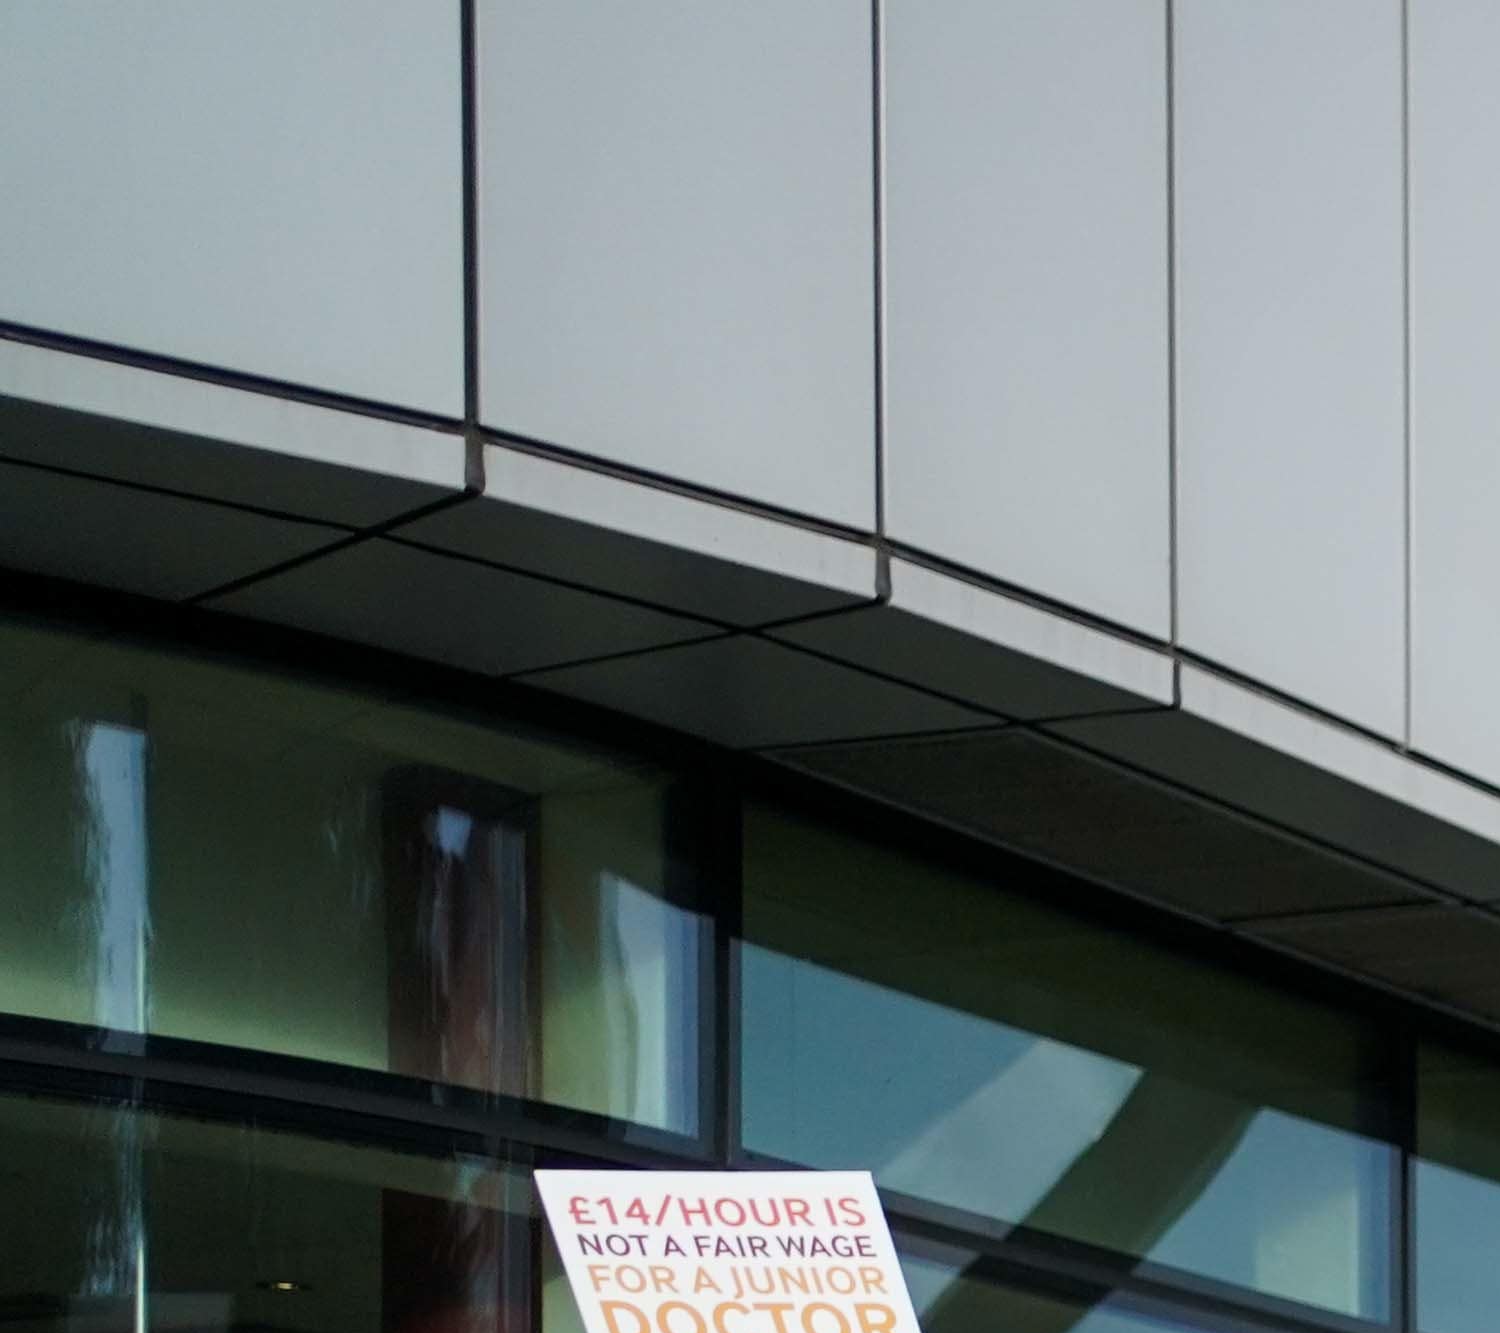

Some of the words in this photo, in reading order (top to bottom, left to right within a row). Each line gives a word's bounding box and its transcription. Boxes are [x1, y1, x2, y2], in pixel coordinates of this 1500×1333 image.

[568, 1194, 814, 1228] £14/HOUR
[823, 1197, 866, 1227] IS
[576, 1233, 649, 1257] NOT
[663, 1235, 687, 1257] A
[693, 1235, 770, 1258] FAIR
[775, 1235, 877, 1258] WAGE
[586, 1263, 679, 1294] FOR
[693, 1266, 723, 1294] A
[730, 1265, 888, 1300] JUNIOR
